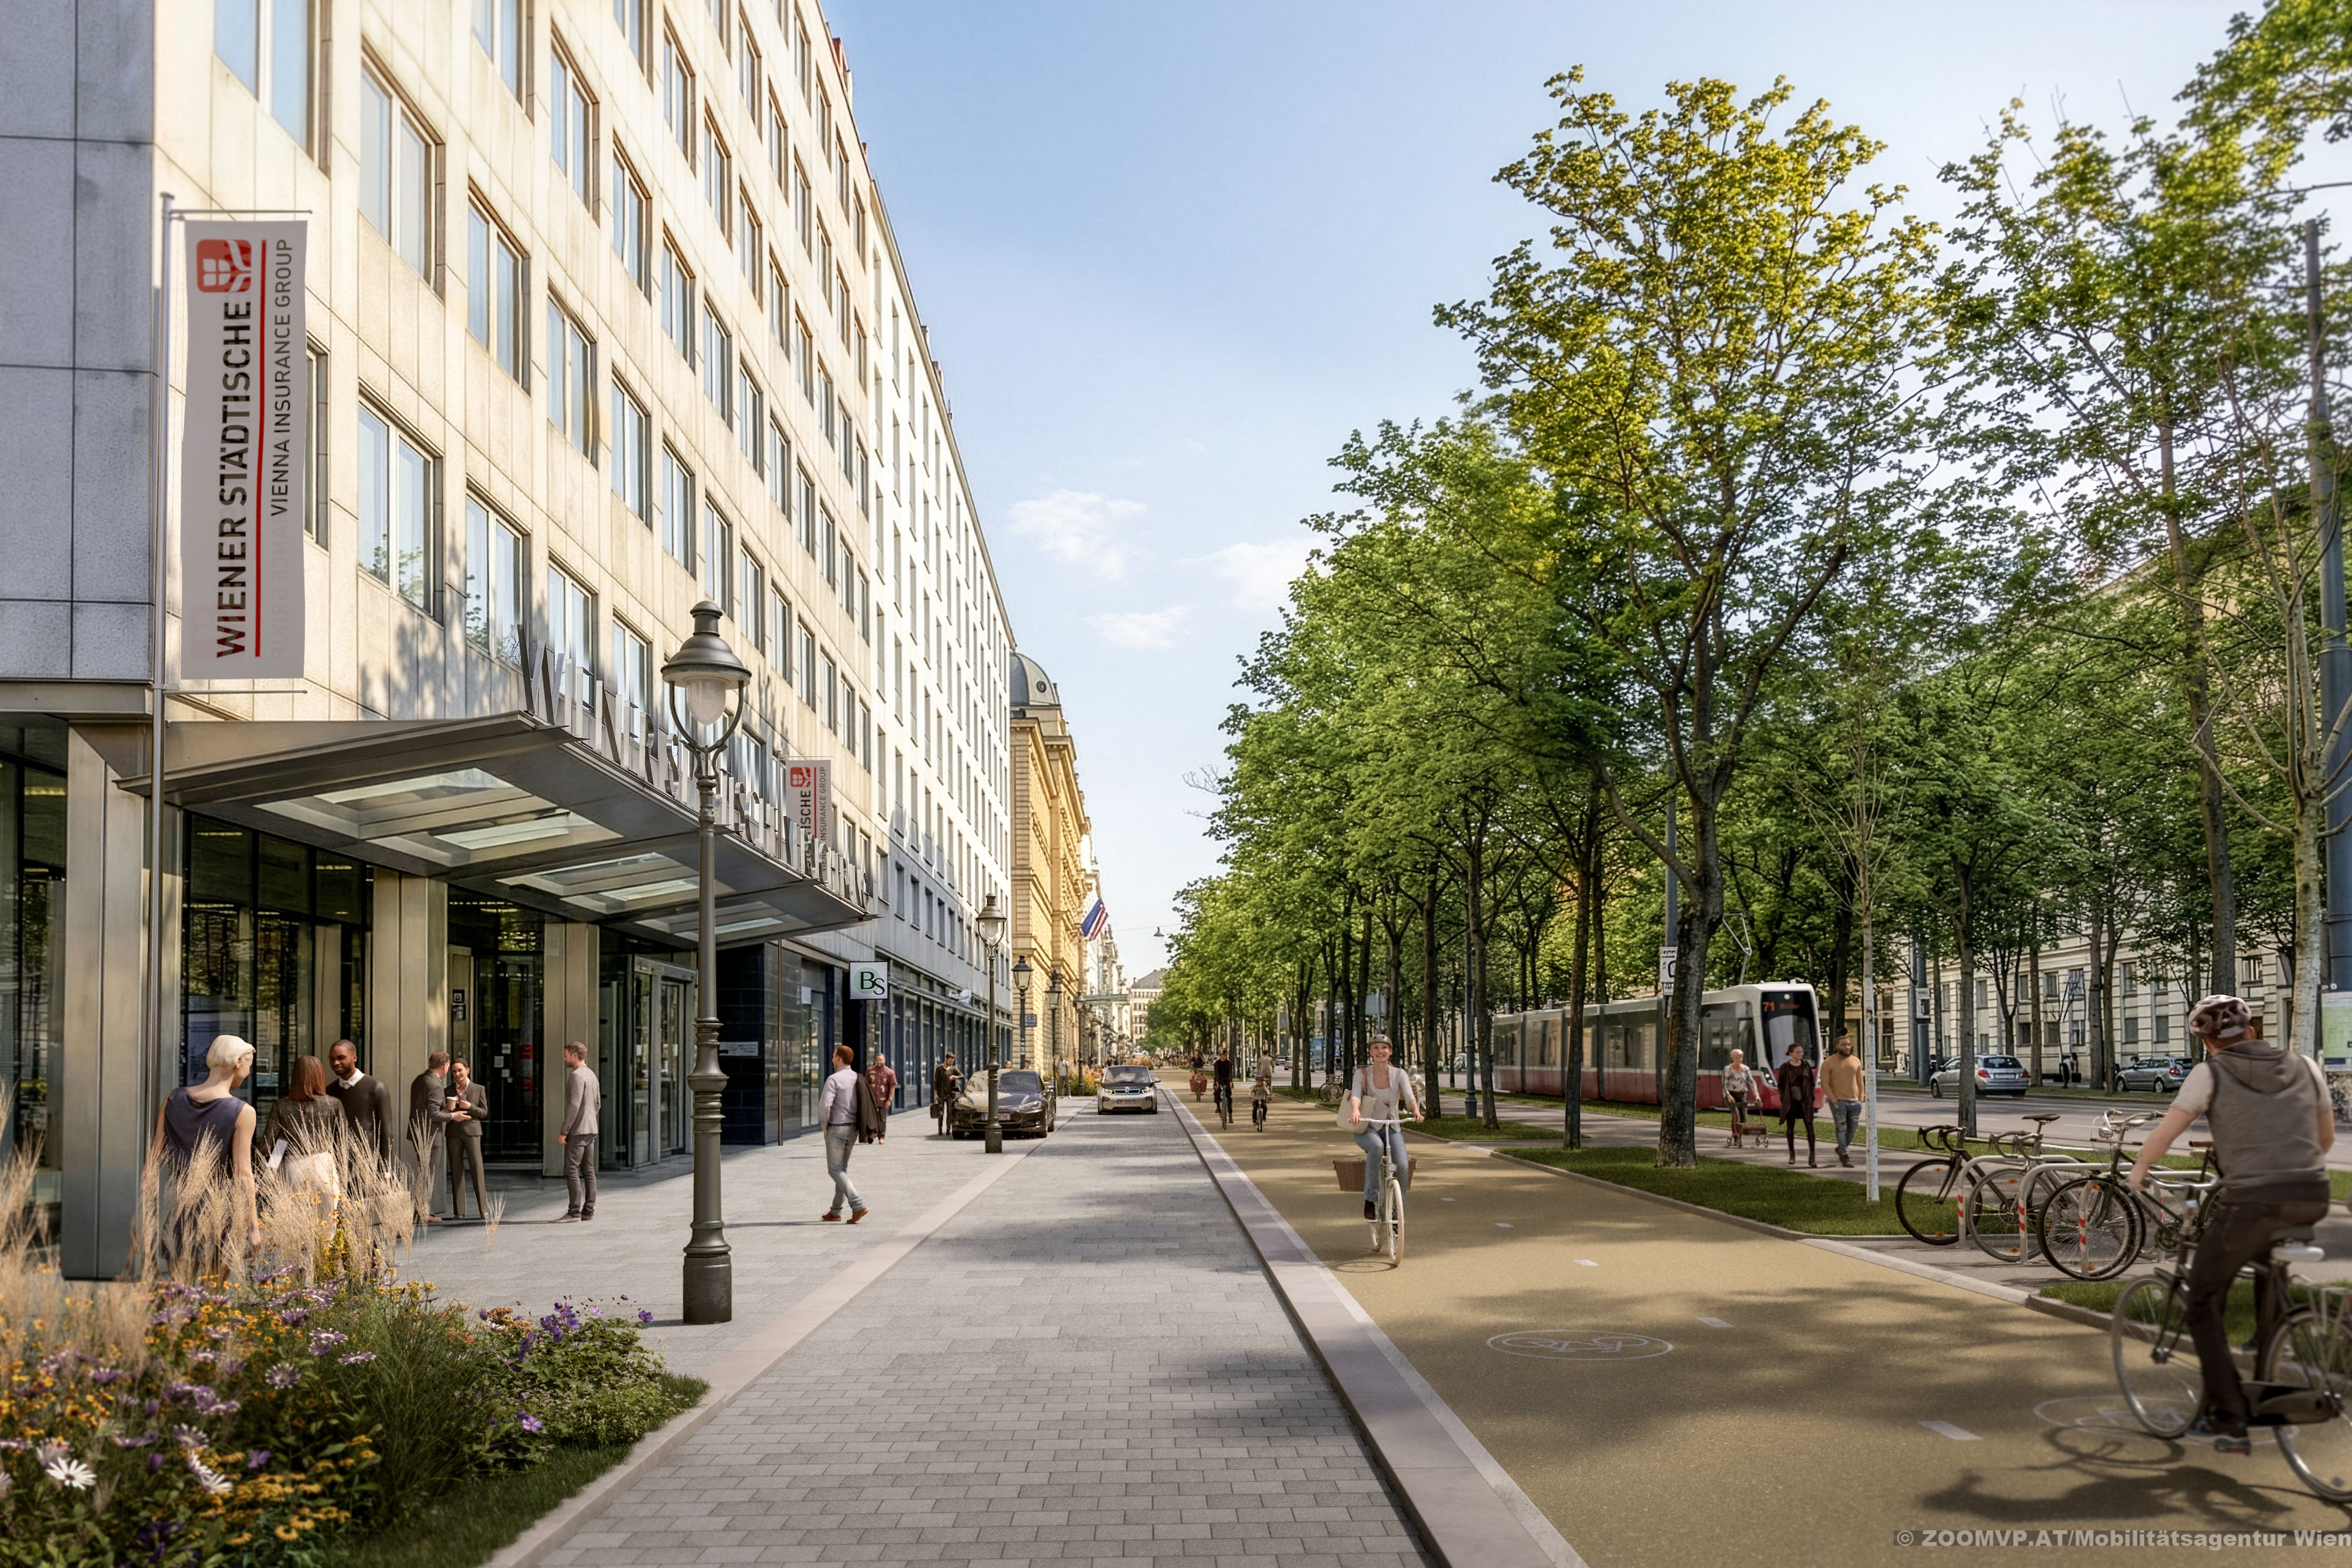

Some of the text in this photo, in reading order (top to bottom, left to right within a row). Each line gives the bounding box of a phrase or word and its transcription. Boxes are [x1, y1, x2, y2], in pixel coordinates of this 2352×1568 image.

[275, 239, 292, 307] GROUP
[273, 315, 290, 433] INSURANCE
[216, 302, 250, 658] WIENER STÄDTISCHE
[271, 439, 290, 516] VIENNA
[517, 624, 654, 785] WIENER
[1762, 1001, 1775, 1012] 71
